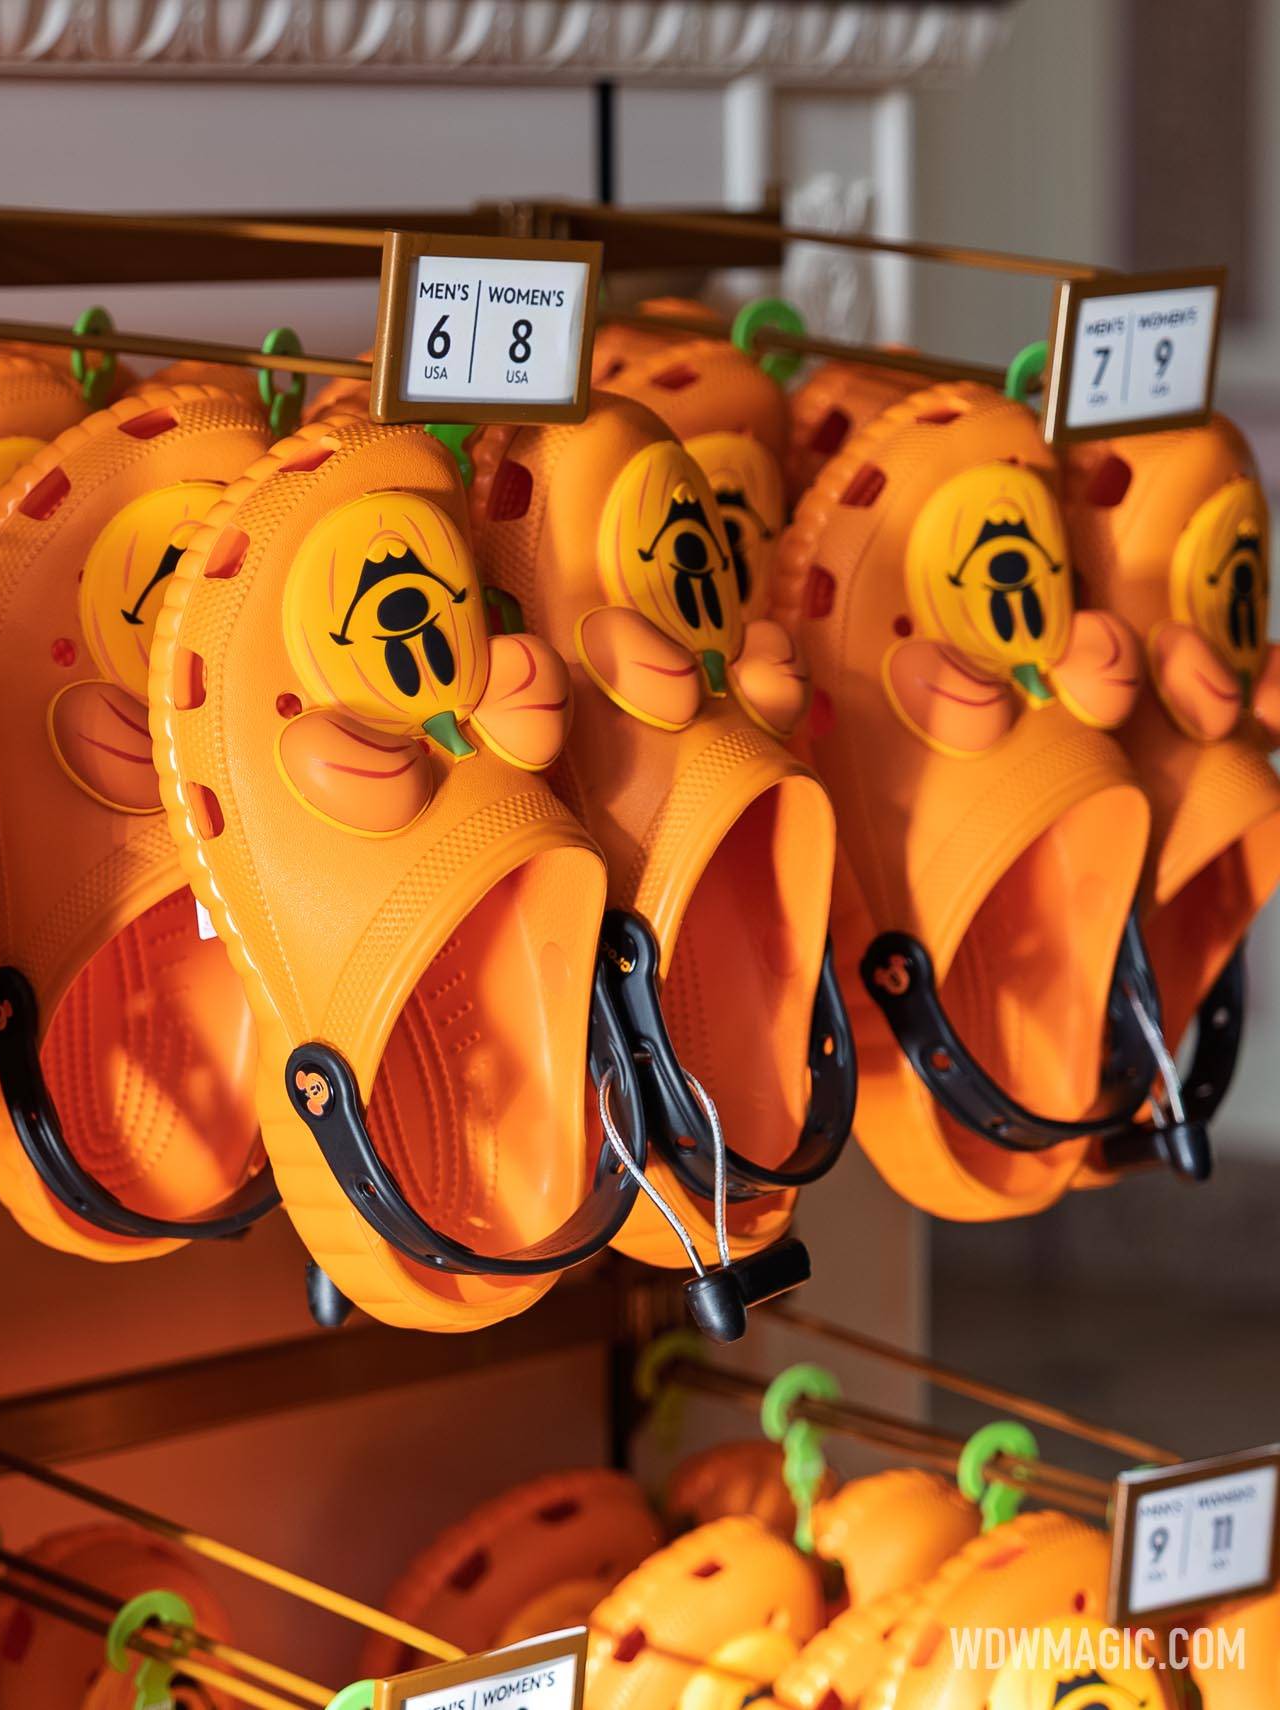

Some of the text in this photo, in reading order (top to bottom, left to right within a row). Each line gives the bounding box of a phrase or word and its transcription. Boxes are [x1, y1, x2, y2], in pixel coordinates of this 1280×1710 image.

[419, 281, 470, 302] MEN'S
[488, 286, 565, 308] WOMEN'S
[426, 314, 451, 360] 6
[508, 318, 533, 364] 8
[424, 365, 448, 380] USA
[506, 369, 529, 384] USA
[1091, 346, 1112, 388] 7
[1154, 338, 1174, 379] 9
[1149, 1526, 1170, 1564] 9
[1212, 1514, 1234, 1553] 11
[482, 1671, 556, 1706] WOMEN'S
